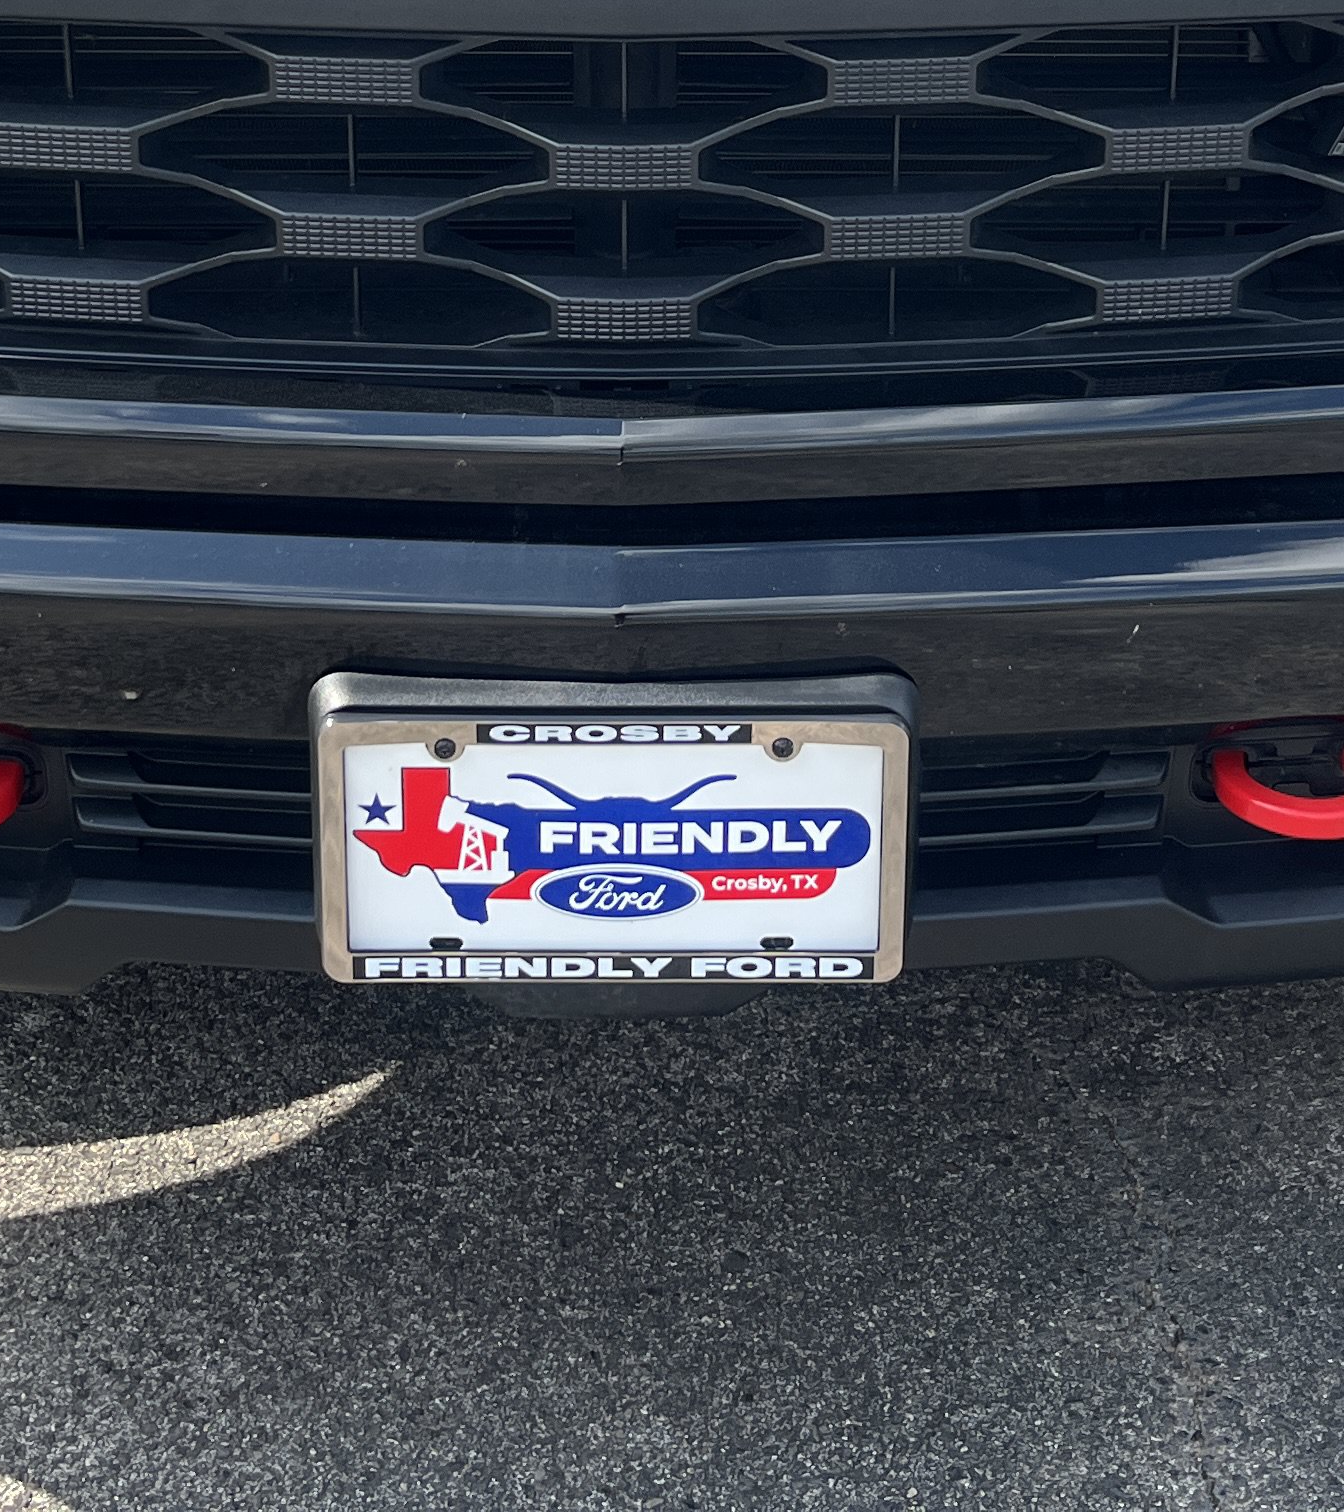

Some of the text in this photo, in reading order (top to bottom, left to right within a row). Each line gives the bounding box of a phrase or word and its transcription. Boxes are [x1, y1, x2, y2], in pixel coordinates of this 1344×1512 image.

[488, 724, 741, 743] CROSBY
[539, 819, 843, 855] FRIENDLY
[568, 873, 667, 911] Ford
[711, 874, 818, 892] Crosby, TX
[364, 956, 864, 979] FRIENDLY FORD
